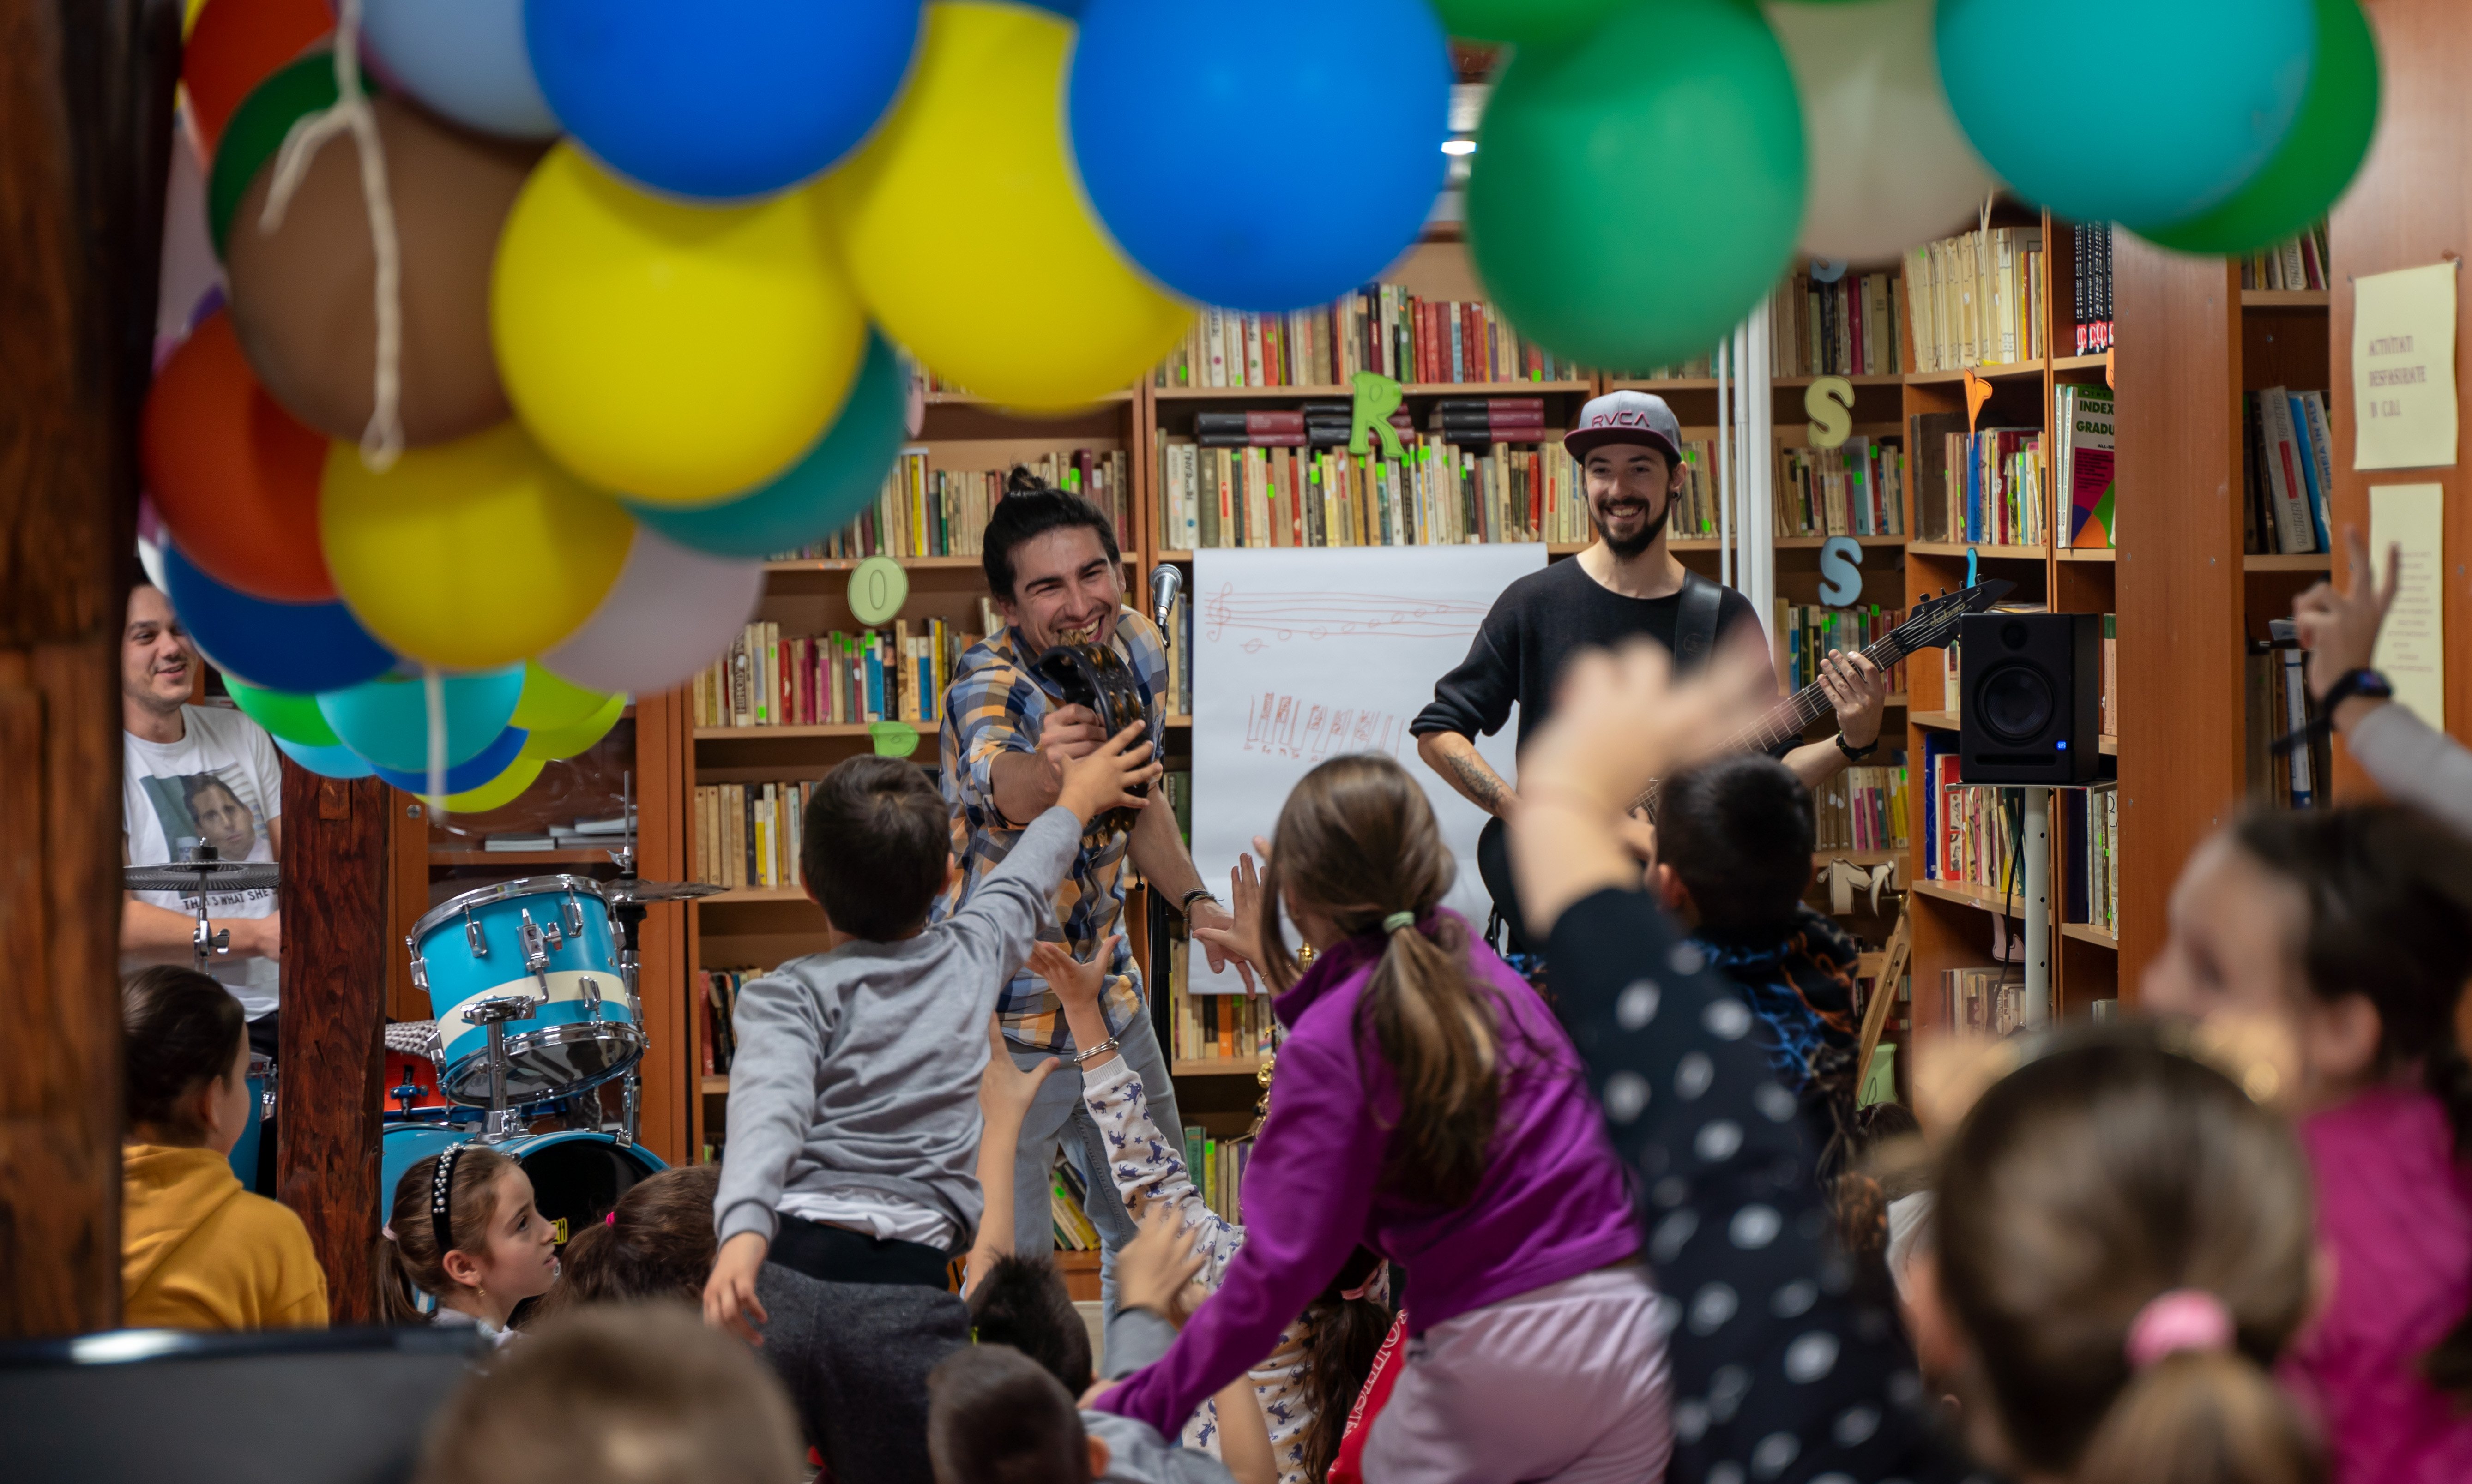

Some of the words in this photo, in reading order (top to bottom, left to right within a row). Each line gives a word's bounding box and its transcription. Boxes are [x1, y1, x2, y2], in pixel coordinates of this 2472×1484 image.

[1348, 370, 1405, 457] R
[1591, 410, 1650, 427] RVCA
[1805, 376, 1855, 449] S
[2079, 399, 2114, 415] INDEX
[1819, 536, 1863, 607] S
[221, 893, 245, 905] WHAT
[247, 889, 269, 901] SHE
